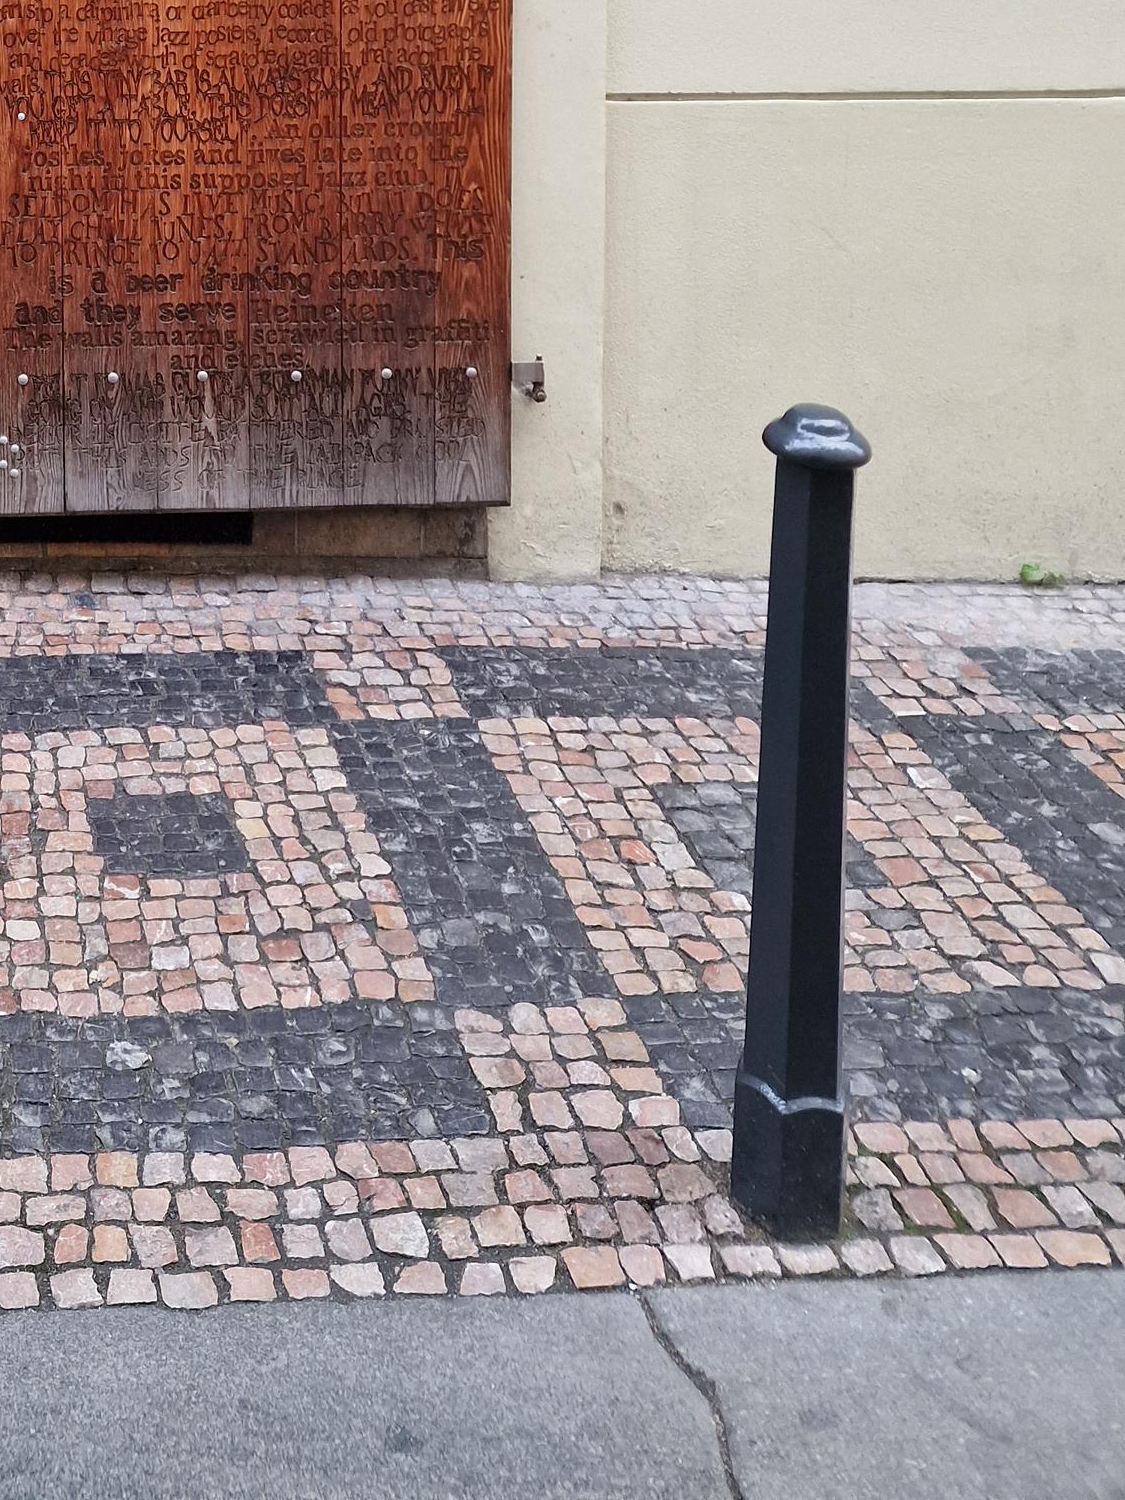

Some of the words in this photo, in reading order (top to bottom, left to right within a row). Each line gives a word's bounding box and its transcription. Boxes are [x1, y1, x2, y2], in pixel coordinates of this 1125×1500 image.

[48, 266, 74, 296] is
[90, 270, 109, 296] a
[15, 299, 63, 326] and
[80, 296, 142, 331] they
